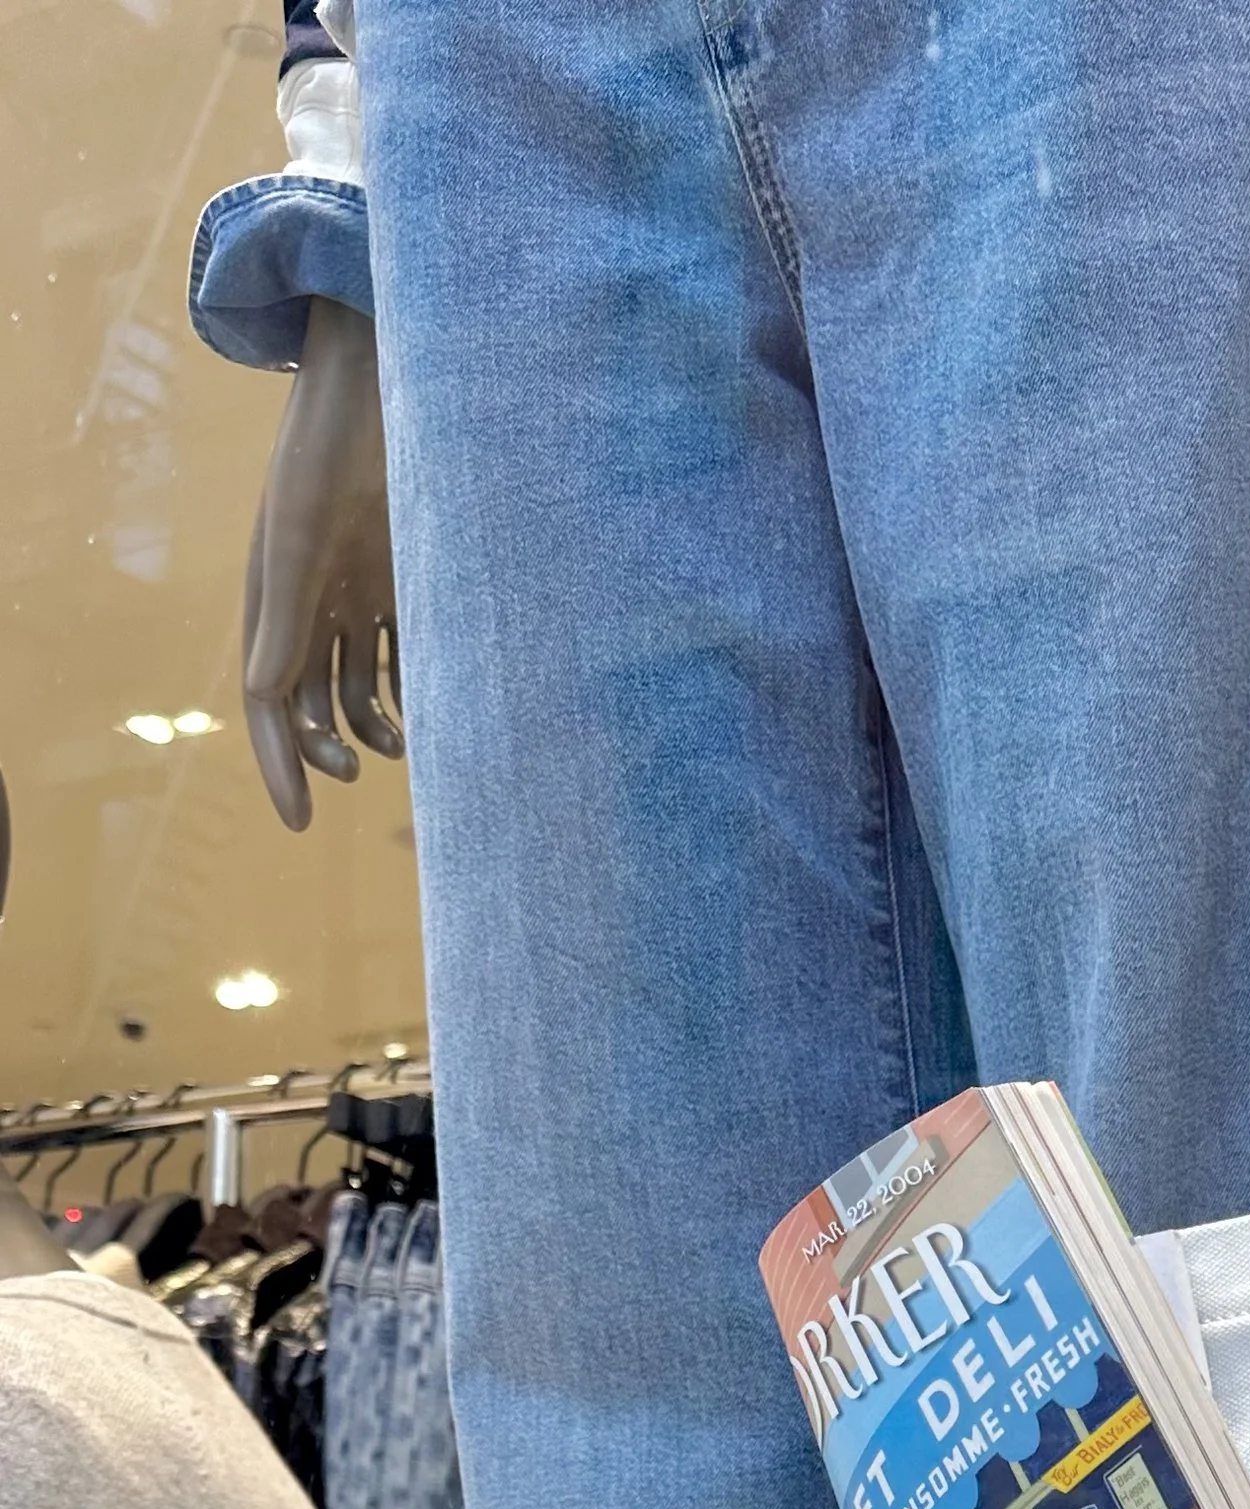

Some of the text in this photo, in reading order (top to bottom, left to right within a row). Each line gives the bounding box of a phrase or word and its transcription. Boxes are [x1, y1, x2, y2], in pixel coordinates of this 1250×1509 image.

[802, 1158, 936, 1264] MAR. 22, 2004
[917, 1274, 1058, 1442] DELI
[1010, 1316, 1100, 1414] FRESH
